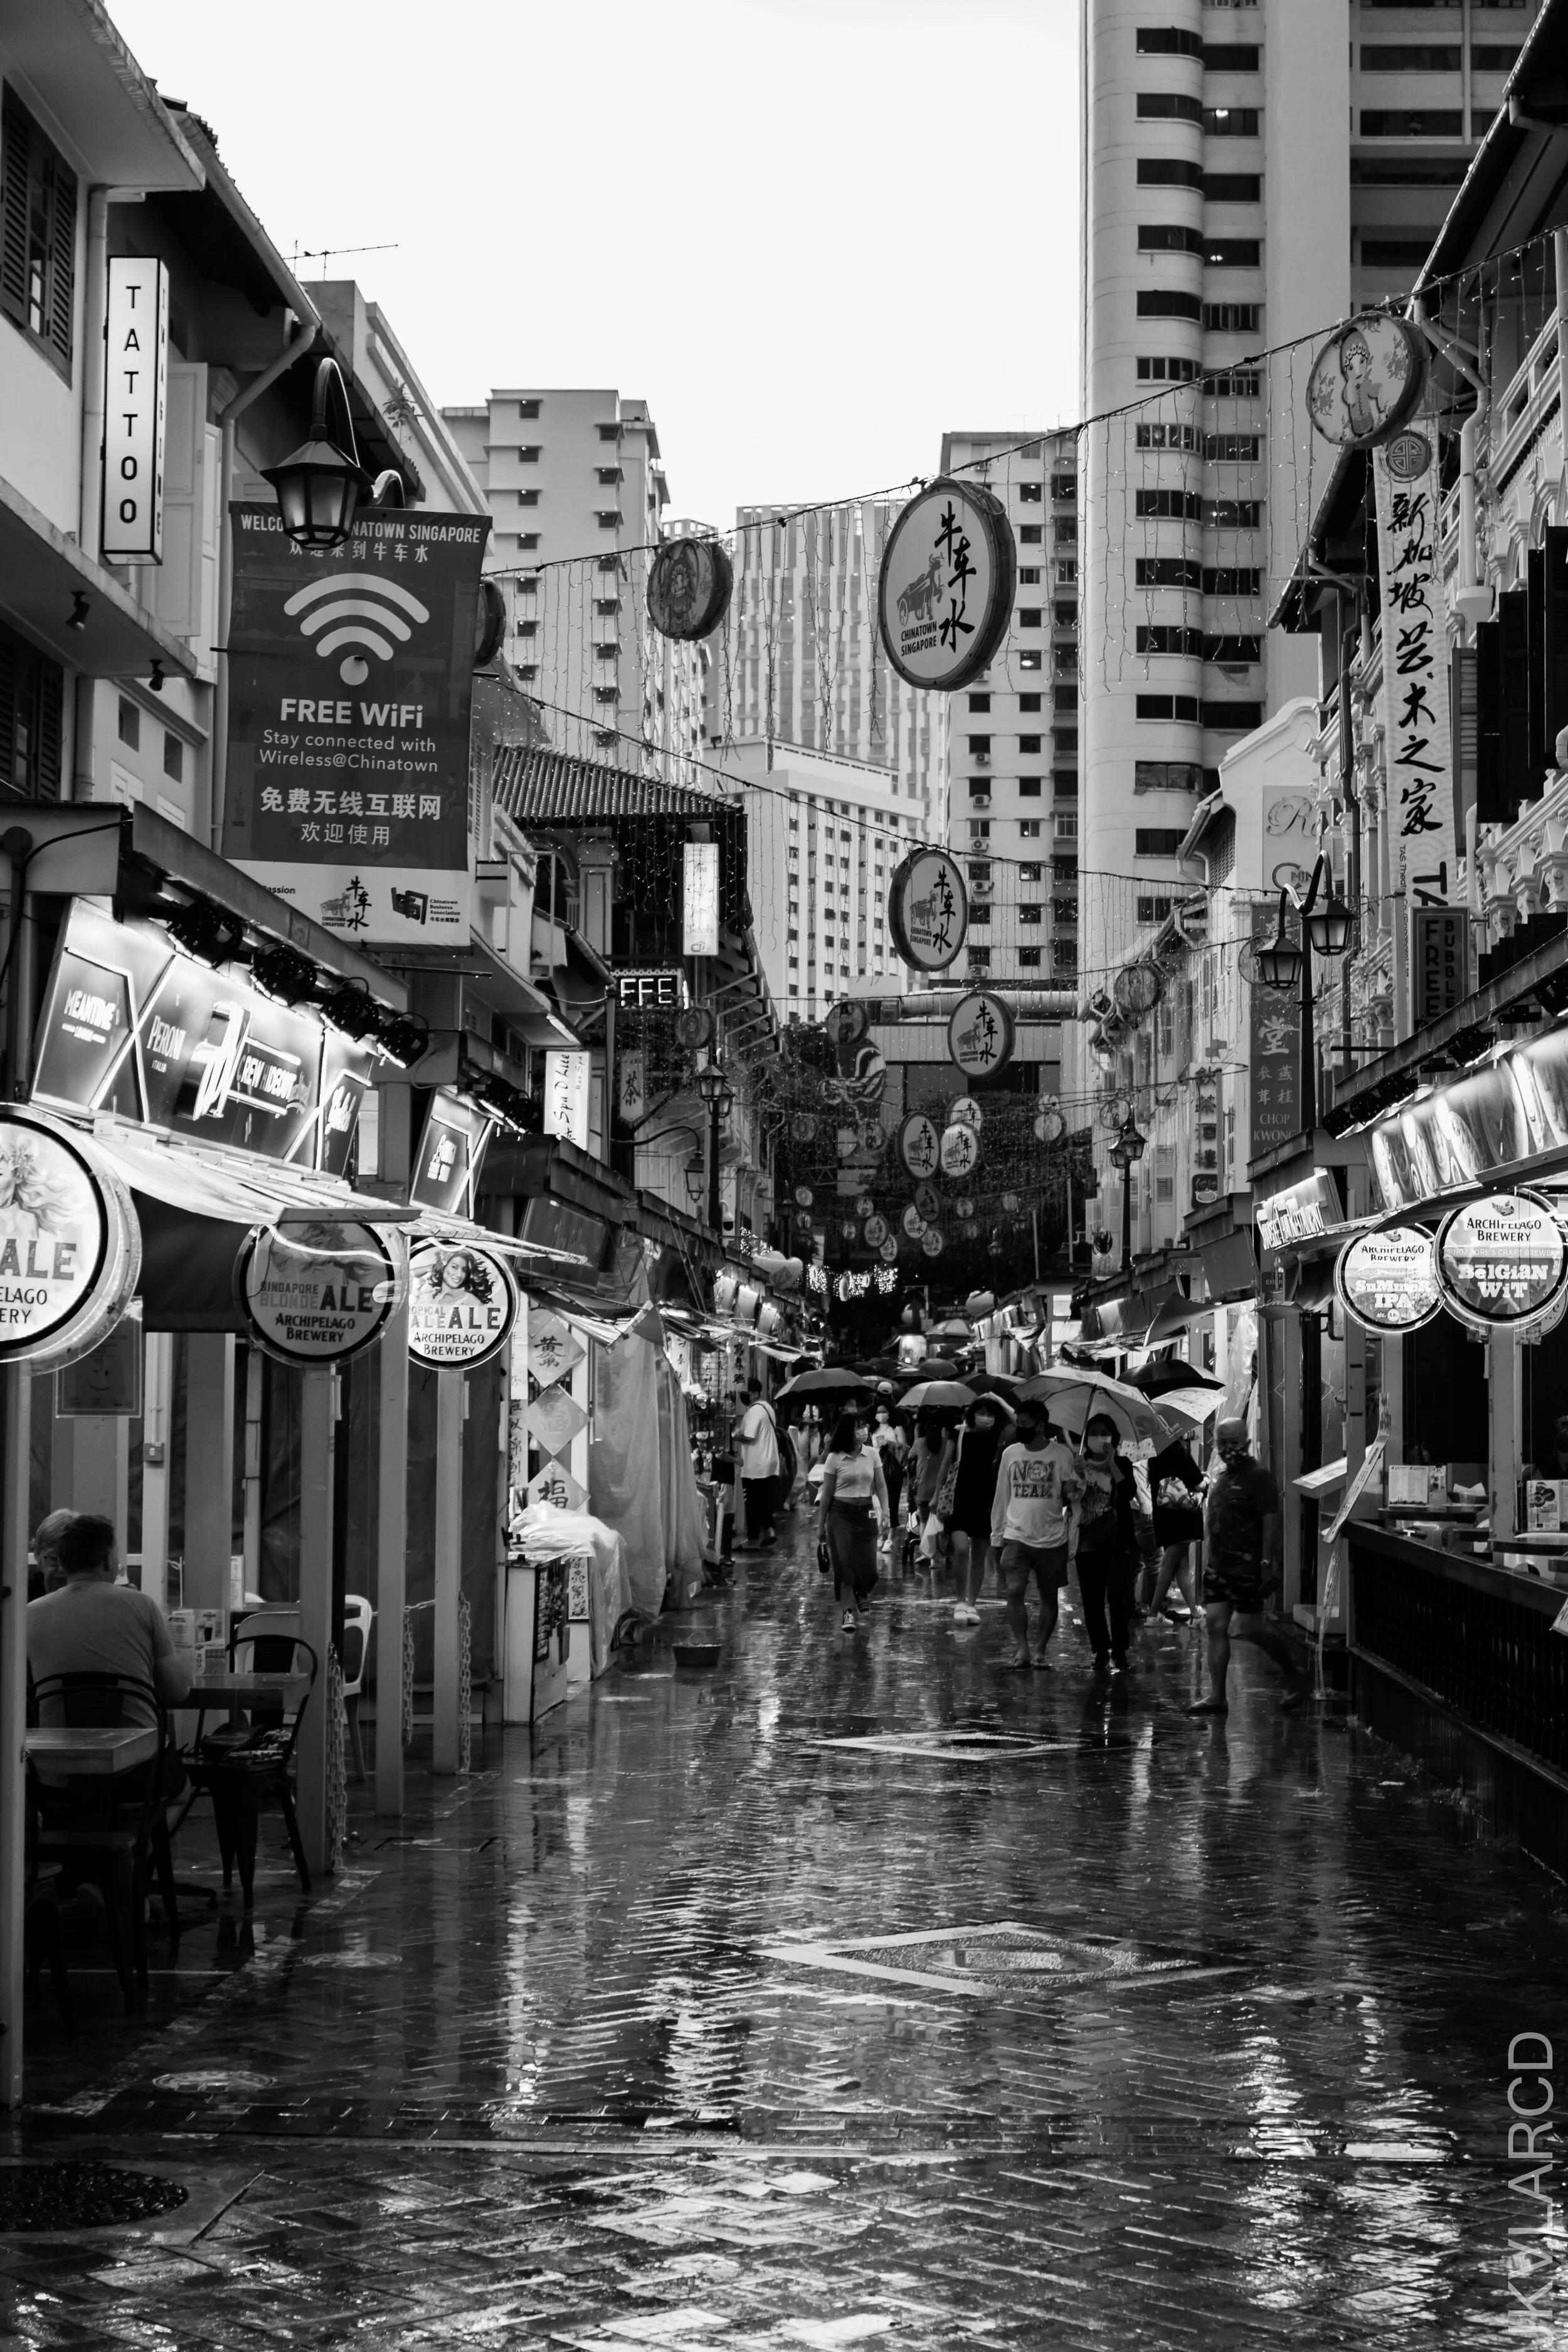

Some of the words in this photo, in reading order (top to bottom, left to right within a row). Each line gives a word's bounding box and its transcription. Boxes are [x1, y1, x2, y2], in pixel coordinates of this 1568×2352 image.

[119, 285, 141, 524] TATTOO
[241, 514, 282, 532] WELCO
[351, 521, 405, 539] NATOWN
[409, 524, 481, 544] SINGAPORE
[935, 500, 977, 653] 牛车水
[901, 620, 937, 642] CHINATOWN
[901, 637, 937, 657] SINGAPORE
[280, 698, 352, 724] FREE
[360, 702, 423, 728] WiFi
[263, 729, 299, 749] Stay
[305, 733, 395, 751] connected
[401, 738, 436, 753] with
[259, 749, 438, 773] Wireless@Chinatown
[259, 786, 441, 820] 免费无线互联网
[300, 822, 391, 846] 欢迎使用
[345, 876, 372, 932] 牛车水
[933, 864, 956, 956] 牛车水
[910, 935, 931, 946] SINGAPORE
[911, 926, 932, 937] CHINATOWN
[1426, 919, 1440, 1017] FREE
[1445, 919, 1455, 1009] BUBBLE
[146, 1015, 187, 1061] PERONI
[975, 1000, 998, 1065] 牛车水
[1259, 1113, 1290, 1126] CHOP
[1466, 1217, 1542, 1229] ARCHIPELAGO
[1477, 1230, 1531, 1241] BREWERY
[0, 1238, 77, 1281] ALE
[1361, 1245, 1424, 1253] ARCHIPELAGO
[260, 1282, 319, 1295] SINGAPORE
[260, 1293, 319, 1310] BLONDE
[320, 1285, 374, 1313] ALE
[1374, 1293, 1412, 1308] IPA
[275, 1312, 356, 1330] ARCHIPELAGO
[411, 1305, 446, 1316] OPICAL
[448, 1306, 501, 1330] ALE
[286, 1328, 344, 1343] BREWERY
[413, 1332, 484, 1345] ARCHIPELAGO
[424, 1344, 475, 1357] BREWERY
